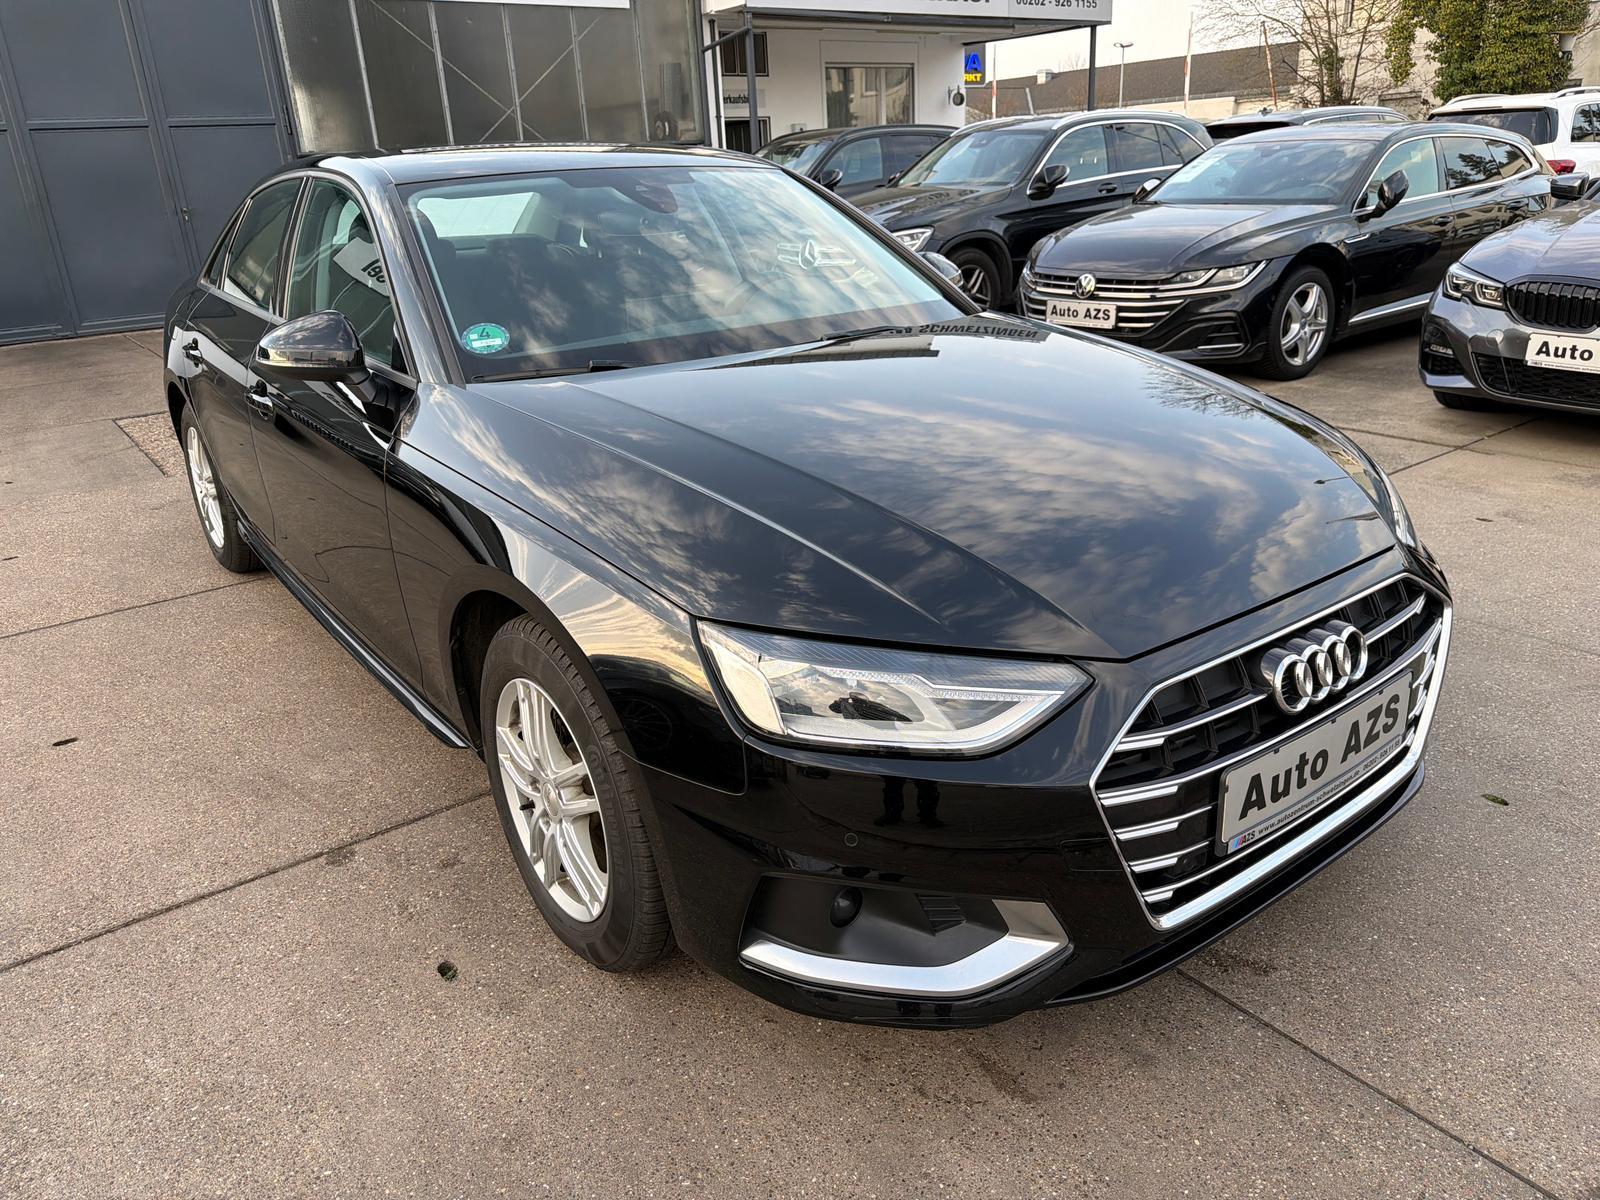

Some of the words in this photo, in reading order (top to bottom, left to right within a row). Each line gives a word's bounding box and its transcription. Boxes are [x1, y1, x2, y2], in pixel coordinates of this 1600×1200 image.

[1075, 0, 1098, 9] 1155
[1050, 304, 1079, 318] Auto
[1083, 307, 1111, 321] AZS
[1535, 340, 1594, 362] Auto
[1238, 748, 1329, 821] Auto
[1340, 693, 1400, 765] AZS
